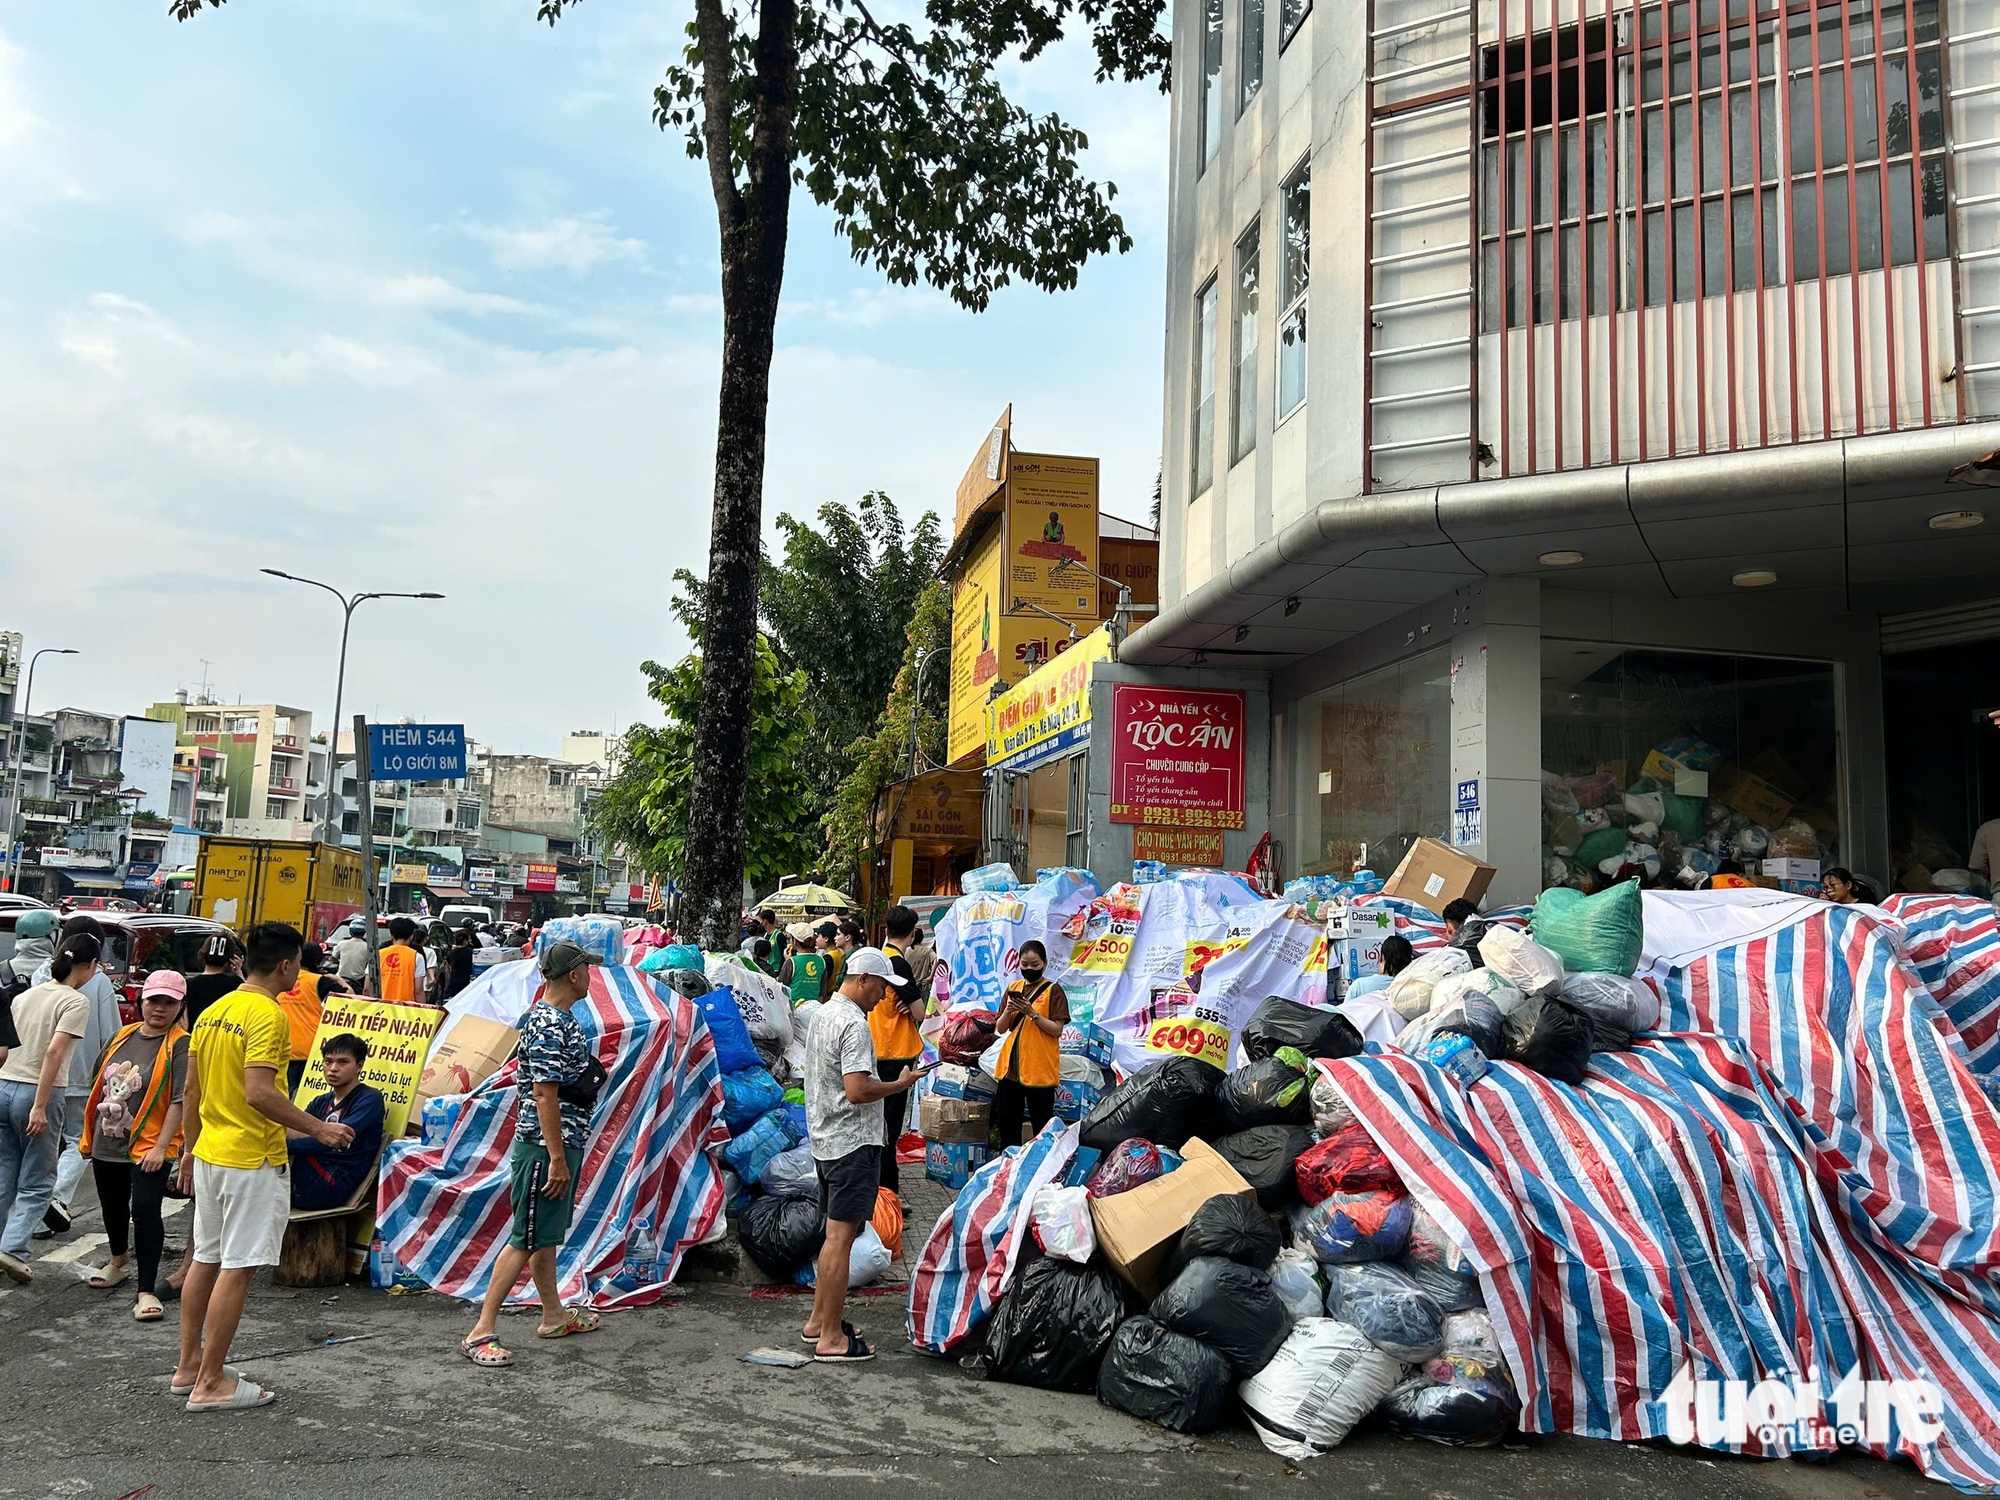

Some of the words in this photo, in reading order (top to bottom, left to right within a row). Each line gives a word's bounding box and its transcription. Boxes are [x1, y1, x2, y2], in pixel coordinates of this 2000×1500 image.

[1060, 661, 1087, 699] 550
[1160, 702, 1179, 714] NHÀ
[1181, 702, 1199, 715] YẾN
[382, 726, 421, 745] HẺM
[427, 729, 456, 745] 544
[1126, 714, 1186, 751] LỘC
[1187, 718, 1234, 749] ÂN
[383, 755, 403, 772] LỘ
[406, 753, 436, 770] GIỚI
[439, 756, 458, 770] 8M
[1146, 758, 1174, 771] CHUYÊN
[1175, 760, 1194, 773] CUNG
[1195, 757, 1210, 774] CẤP
[1146, 775, 1160, 784] yến
[1146, 785, 1160, 794] yến
[1161, 786, 1184, 796] chưng
[1460, 783, 1476, 800] 546
[1146, 795, 1160, 804] yến
[1161, 797, 1179, 806] sạch
[1180, 799, 1206, 808] nguyên
[1207, 797, 1224, 807] chất
[916, 806, 933, 820] SÀI
[937, 807, 961, 821] GÒN
[1111, 804, 1130, 814] ĐT
[1143, 806, 1243, 820] 0931.804.637
[909, 823, 931, 833] BAO
[935, 823, 965, 835] DUNG
[1143, 816, 1244, 828] 0764.228.447
[1137, 831, 1153, 847] CHO
[1154, 829, 1174, 849] THUÊ
[1177, 831, 1192, 849] VĂN
[1195, 831, 1220, 851] PHÒNG
[268, 854, 282, 862] BÁO
[1146, 851, 1159, 860] ĐT:
[1160, 852, 1179, 861] 0931
[1182, 853, 1195, 862] 804
[1198, 854, 1212, 863] 637
[1352, 911, 1380, 921] Dasan
[1110, 923, 1124, 934] 10
[321, 1004, 357, 1029] ĐIỂM
[359, 1010, 388, 1033] TIẾP
[389, 1017, 434, 1041] NHẬN
[1195, 1007, 1220, 1023] 635
[1060, 1029, 1082, 1041] aVie
[1152, 1025, 1229, 1055] 609.000
[378, 1041, 417, 1064] PHẨM
[388, 1071, 398, 1085] lũ
[400, 1073, 412, 1089] lụt
[303, 1076, 326, 1091] Miền
[390, 1090, 408, 1105] Bắc
[1054, 1088, 1072, 1101] Vie
